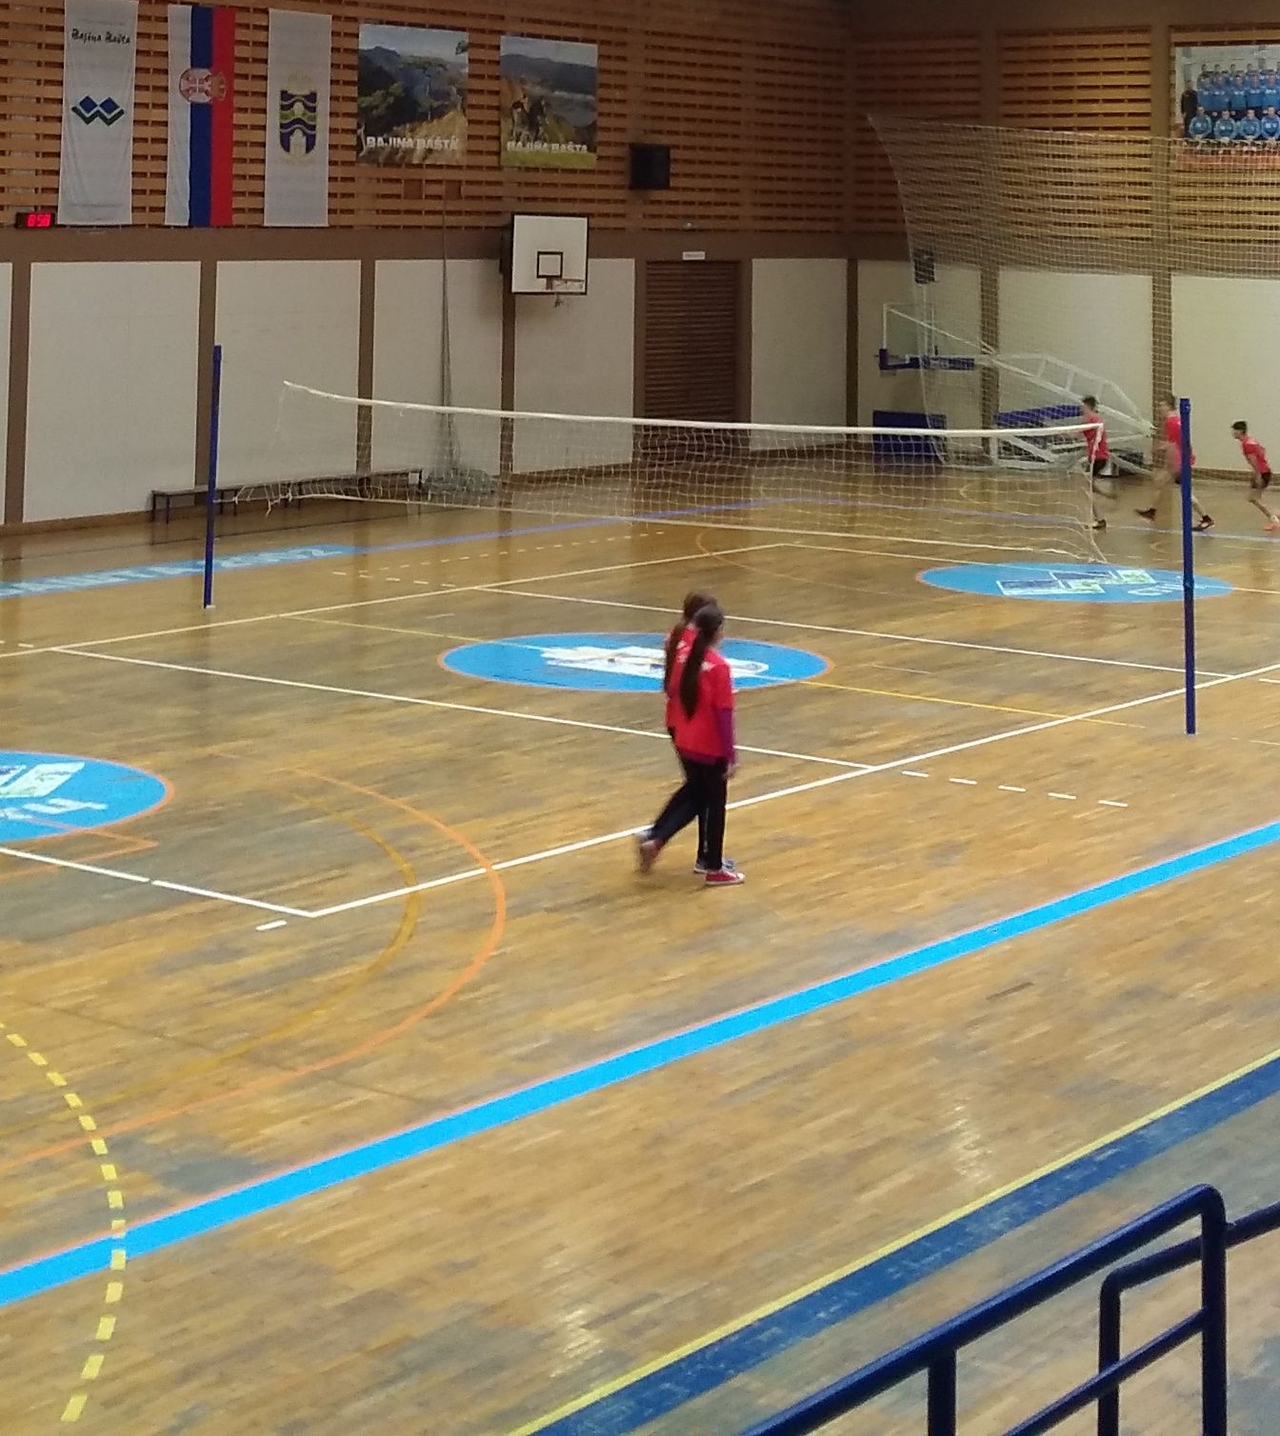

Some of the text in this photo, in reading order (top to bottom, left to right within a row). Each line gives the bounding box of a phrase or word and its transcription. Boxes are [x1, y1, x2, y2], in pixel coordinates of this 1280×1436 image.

[366, 136, 458, 150] BAJINA BAŠTA
[507, 141, 588, 153] BAJINA BAŠTA
